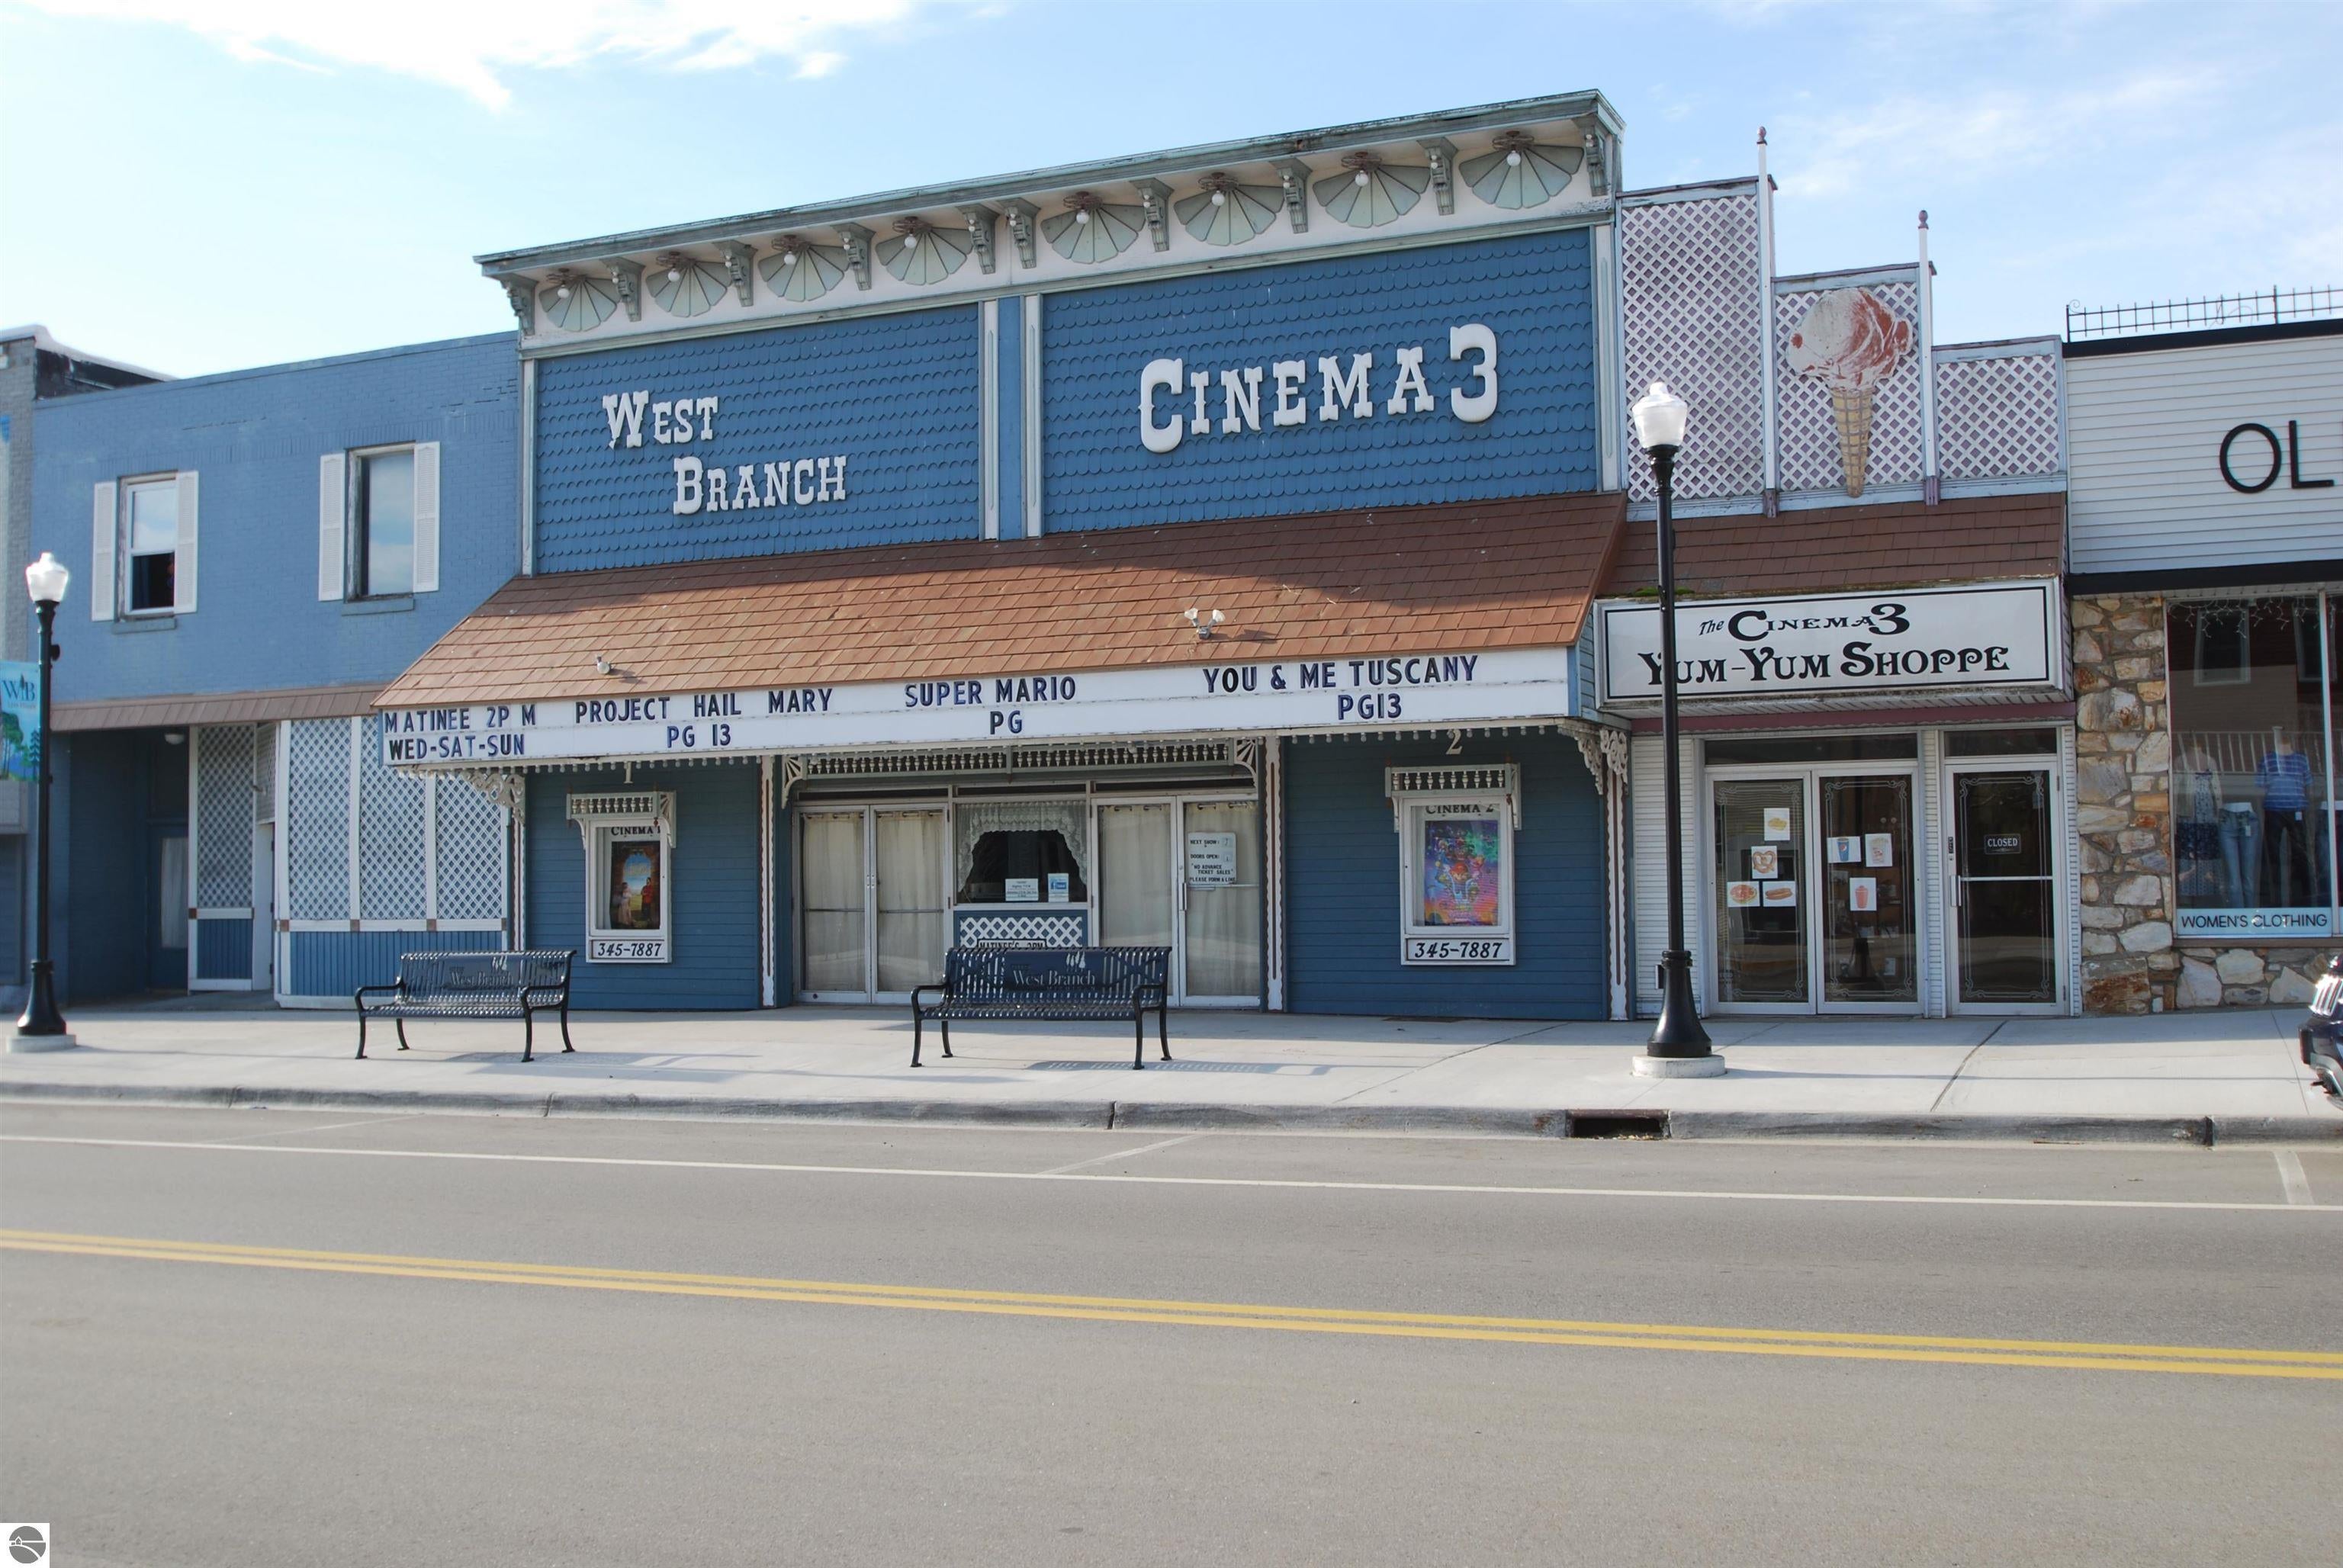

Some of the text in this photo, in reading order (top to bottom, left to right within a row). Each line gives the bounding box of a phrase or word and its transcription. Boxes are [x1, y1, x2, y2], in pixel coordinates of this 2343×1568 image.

[603, 390, 718, 450] WEST
[2219, 420, 2343, 494] OL
[673, 455, 847, 515] BRANCH
[1699, 619, 1724, 636] The
[1840, 641, 2010, 676] SHOPPE
[1203, 654, 1478, 693] YOU & ME TUSCANY
[905, 676, 1076, 708] SUPER MARIO
[576, 688, 833, 724] PROJECT HAIL MARY
[1338, 693, 1403, 721] PG13
[384, 706, 471, 734] MATINEE
[990, 710, 1023, 734] PG
[389, 734, 525, 760] WED-SAT-SUN
[667, 723, 732, 749] PG 13
[611, 826, 654, 836] CINEMA
[1987, 837, 2018, 848] CLOSED
[2181, 914, 2328, 928] WOMEN'S CLOTHING
[598, 943, 662, 957] 345-7887
[1415, 942, 1503, 959] 345-7887
[1012, 969, 1096, 986] West Branch
